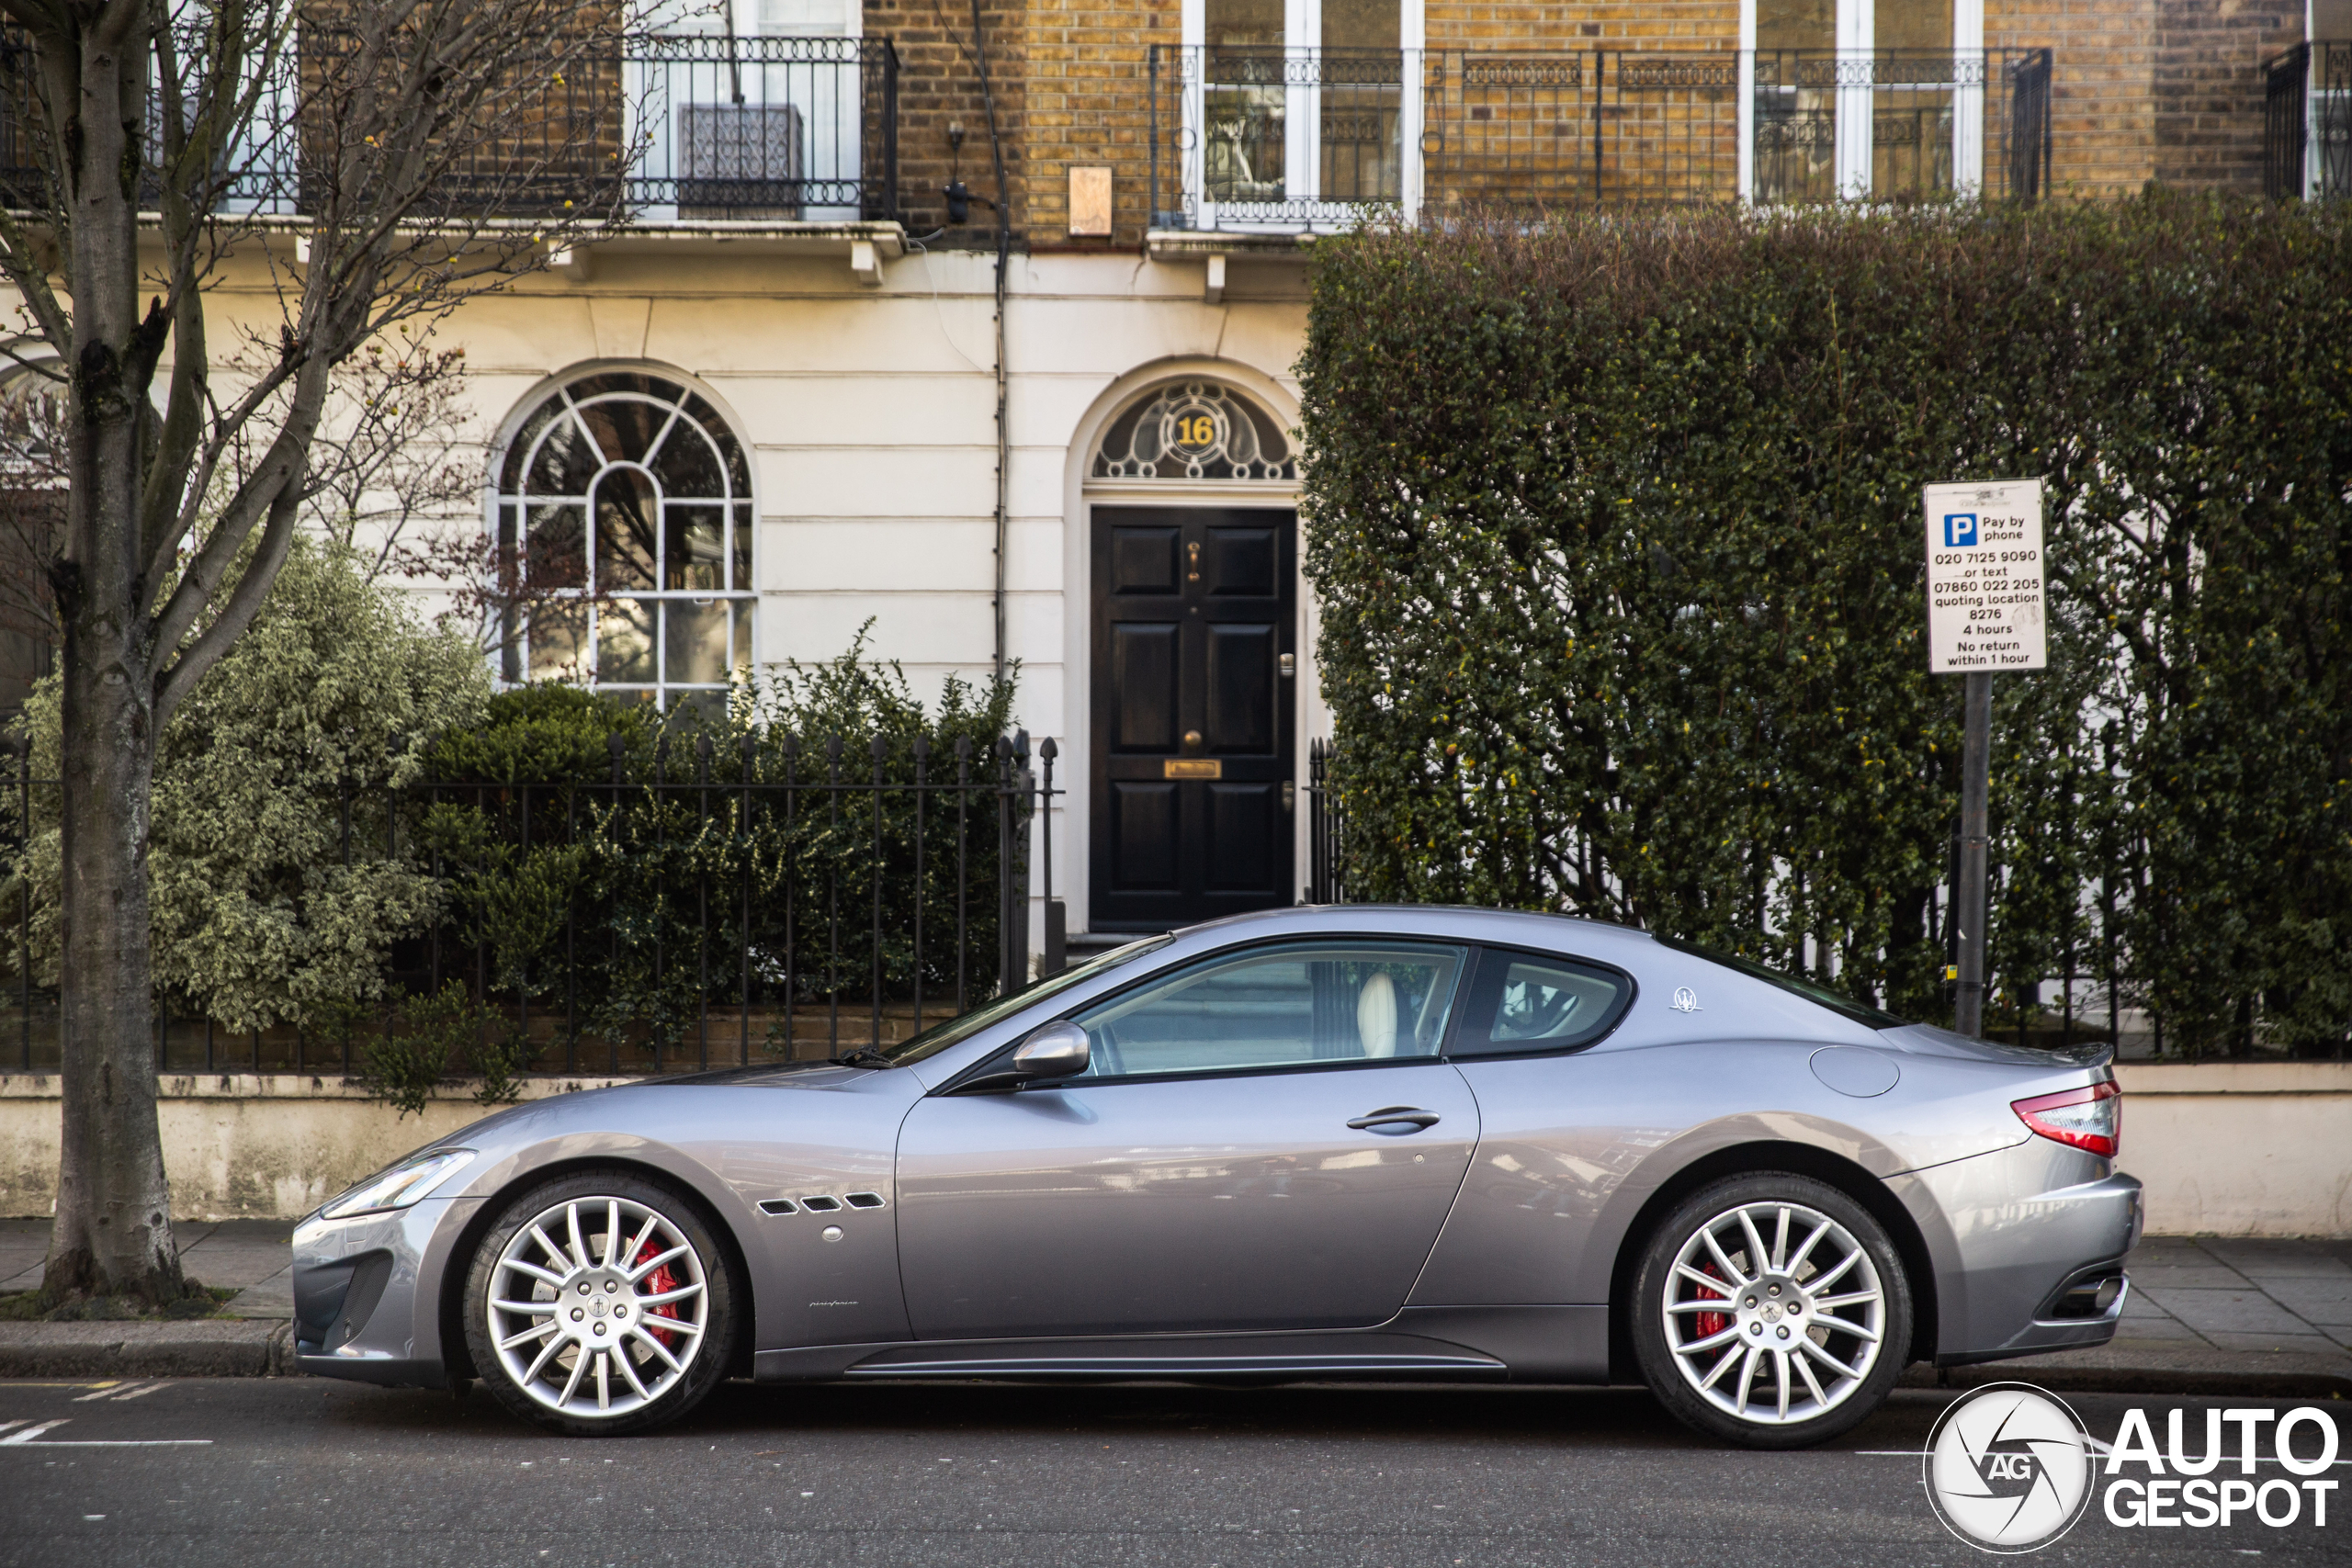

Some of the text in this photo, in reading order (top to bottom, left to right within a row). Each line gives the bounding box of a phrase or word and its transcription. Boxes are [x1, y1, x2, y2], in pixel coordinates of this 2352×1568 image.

[1178, 416, 1214, 445] 16
[1983, 516, 2025, 528] Pay by
[1952, 517, 1973, 545] P
[1984, 530, 2023, 542] phone
[1935, 550, 2037, 565] 020 7125 9090
[1964, 567, 2007, 578] or text
[1934, 579, 2040, 592] 07860 022 205
[1935, 592, 2039, 607] quoting location
[1970, 609, 2002, 620] 8276
[1963, 625, 2013, 635] 4 hours
[1958, 641, 2019, 651] No return
[1948, 653, 2030, 666] within 1 hour
